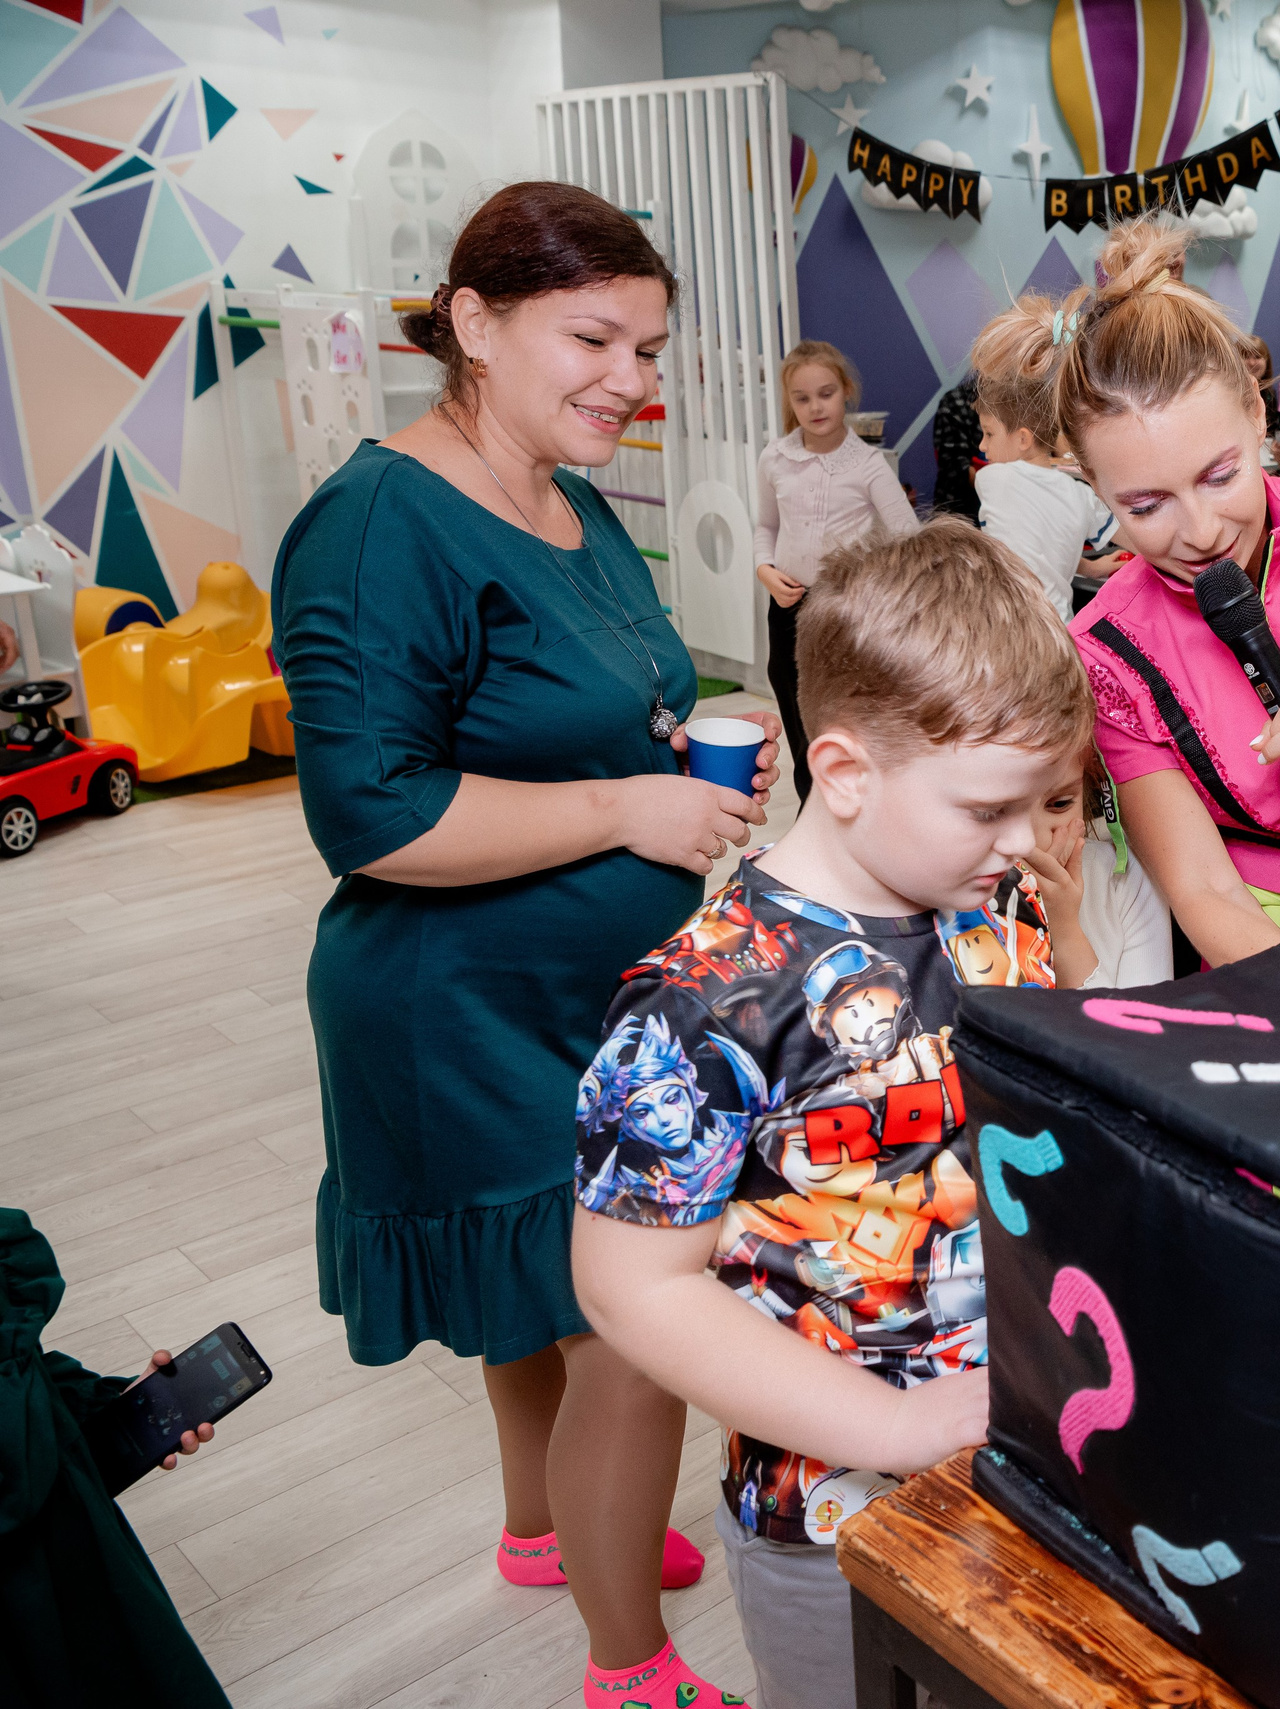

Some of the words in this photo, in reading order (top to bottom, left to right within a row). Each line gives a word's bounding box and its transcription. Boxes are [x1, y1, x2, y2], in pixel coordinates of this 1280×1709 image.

[853, 138, 975, 207] HAPPY
[1100, 780, 1115, 821] GIVE
[501, 1542, 560, 1558] АВОКА
[587, 1667, 658, 1693] ОКАДО
